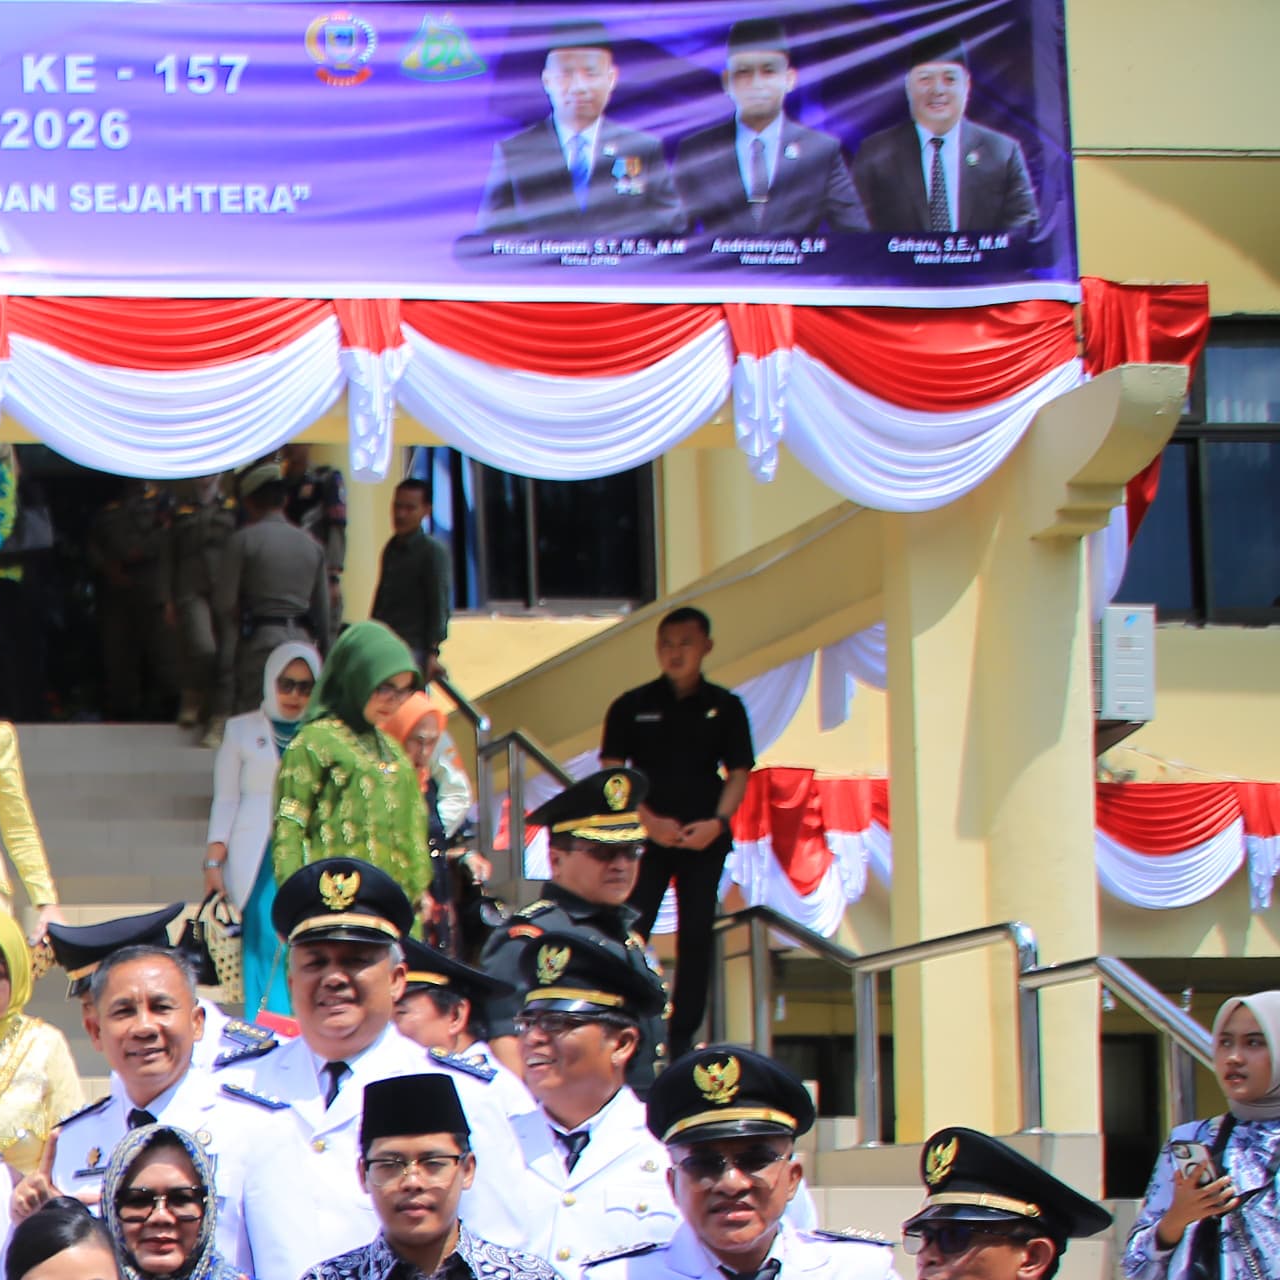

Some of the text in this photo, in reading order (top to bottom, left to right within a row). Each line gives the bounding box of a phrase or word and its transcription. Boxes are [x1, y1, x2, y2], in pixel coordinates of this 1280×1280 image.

[23, 55, 96, 93] KE
[155, 54, 249, 94] 157
[0, 110, 132, 149] 2026
[70, 184, 310, 214] SEJAHTERA”
[801, 238, 825, 253] S.H
[888, 238, 940, 254] Gaharu,
[979, 235, 1009, 251] M.M
